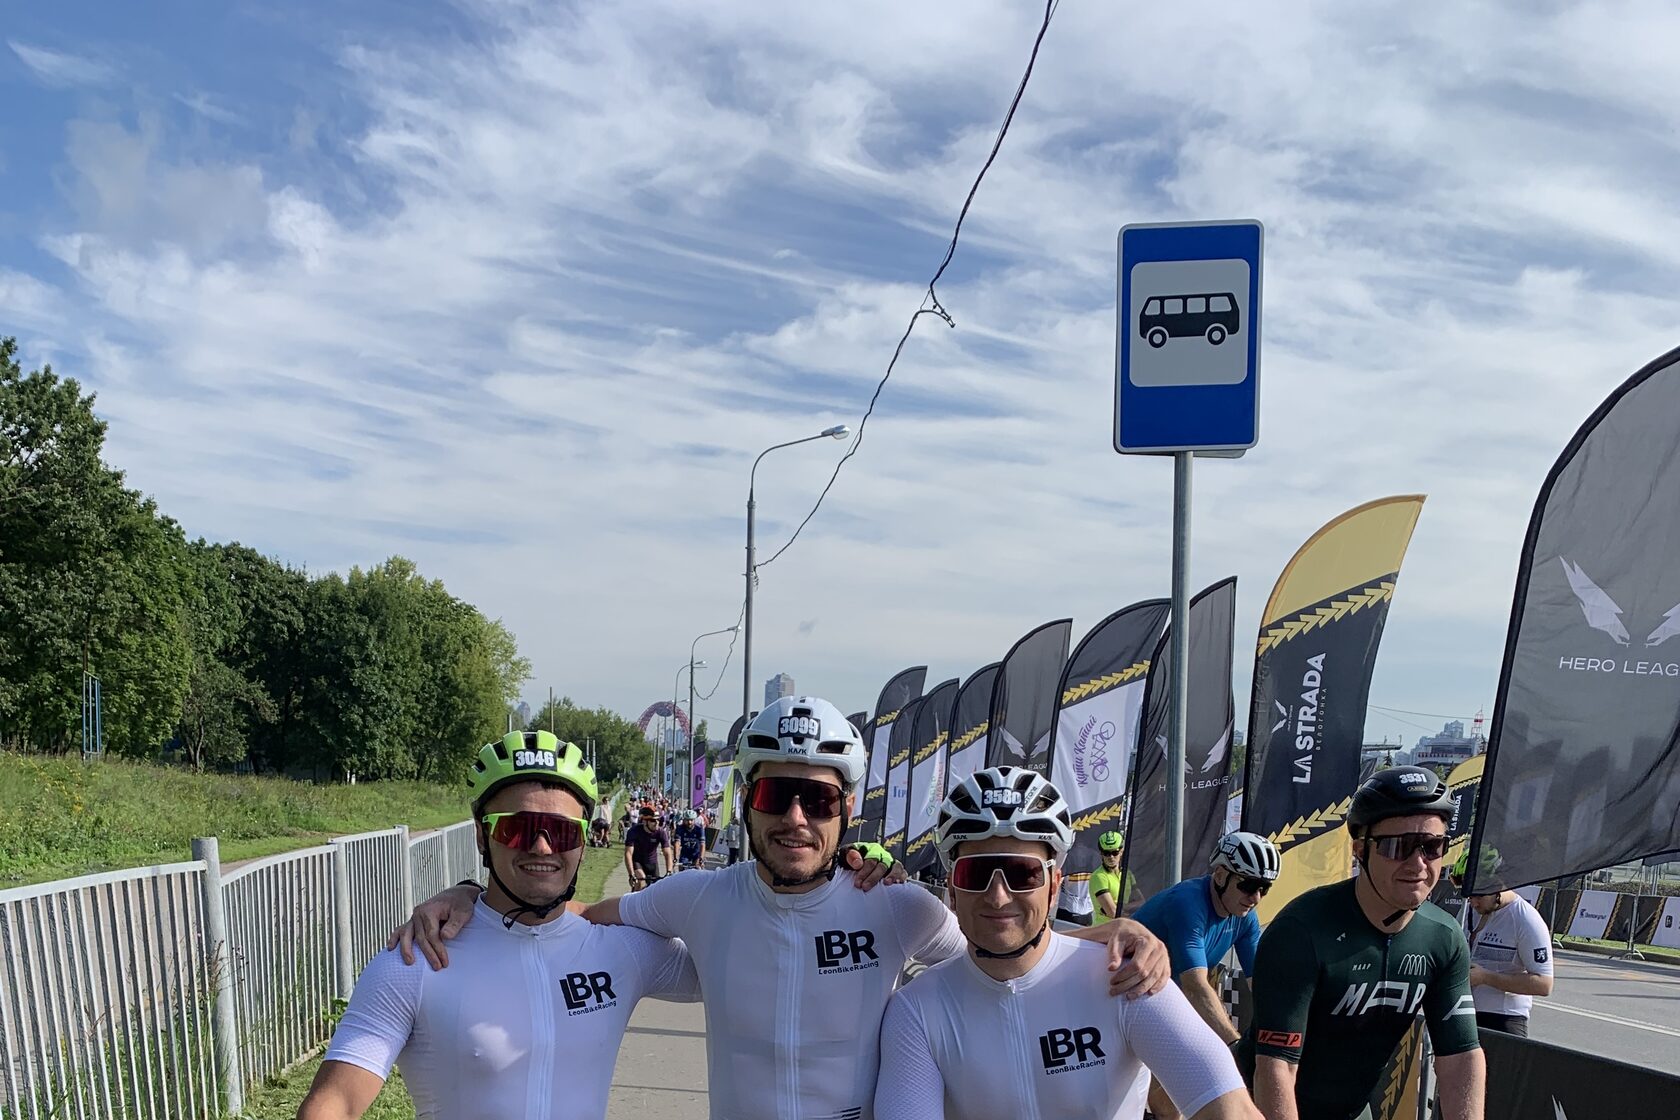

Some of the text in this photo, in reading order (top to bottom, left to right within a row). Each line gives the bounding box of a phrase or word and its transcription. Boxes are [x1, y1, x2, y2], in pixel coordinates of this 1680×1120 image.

[1559, 656, 1616, 672] HERO
[780, 717, 819, 734] 3099
[1293, 653, 1326, 784] LA STRADA
[515, 750, 555, 768] 3046
[1399, 773, 1427, 784] 3531
[984, 789, 1021, 805] 3580
[815, 930, 879, 968] LBR
[818, 961, 879, 975] LeonBikeRacing
[559, 971, 617, 1010] LBR
[568, 1000, 617, 1016] LeonBikeRacing
[1039, 1026, 1106, 1068] LBR
[1046, 1058, 1106, 1075] LeonBikeRacing
